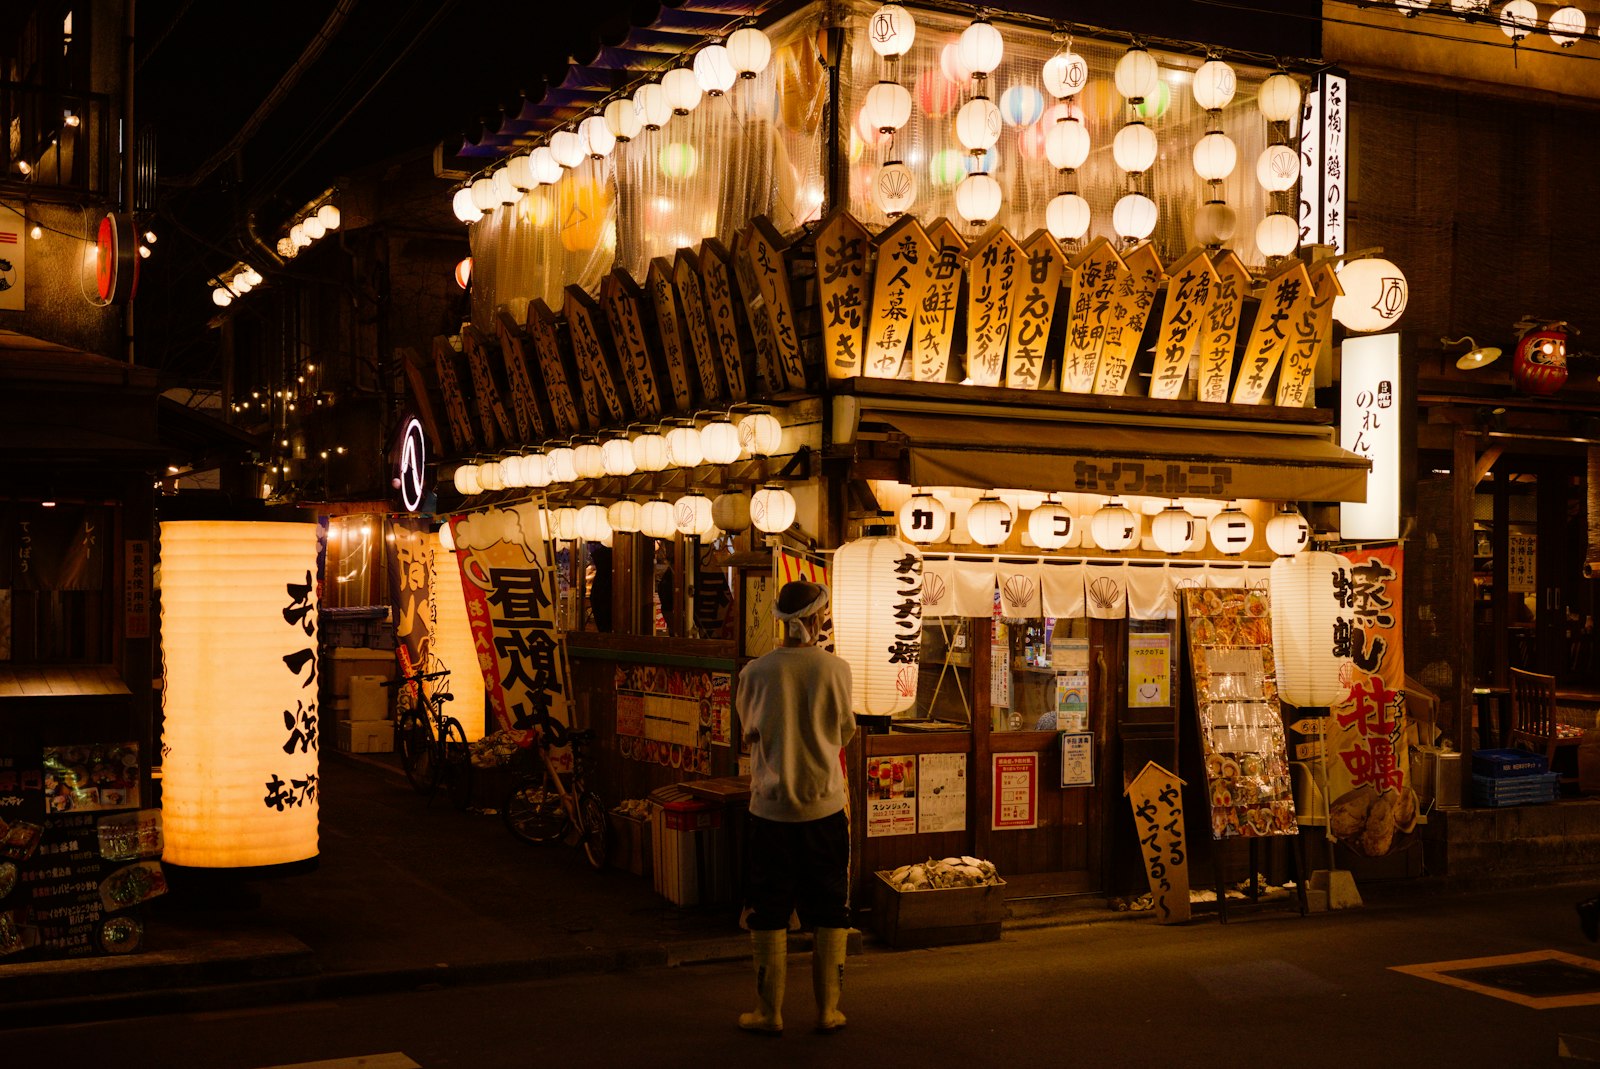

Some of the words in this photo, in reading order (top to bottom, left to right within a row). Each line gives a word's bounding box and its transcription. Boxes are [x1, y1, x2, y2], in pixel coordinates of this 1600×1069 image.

[824, 235, 862, 367] 浜焼き
[919, 236, 961, 383] 海鮮チャンジ
[1193, 271, 1210, 305] 名物
[1353, 390, 1380, 473] のれん
[1074, 460, 1232, 494] カイフォルニア
[18, 521, 32, 573] てっぽう
[82, 521, 96, 560] レバー
[1159, 784, 1184, 865] やってる
